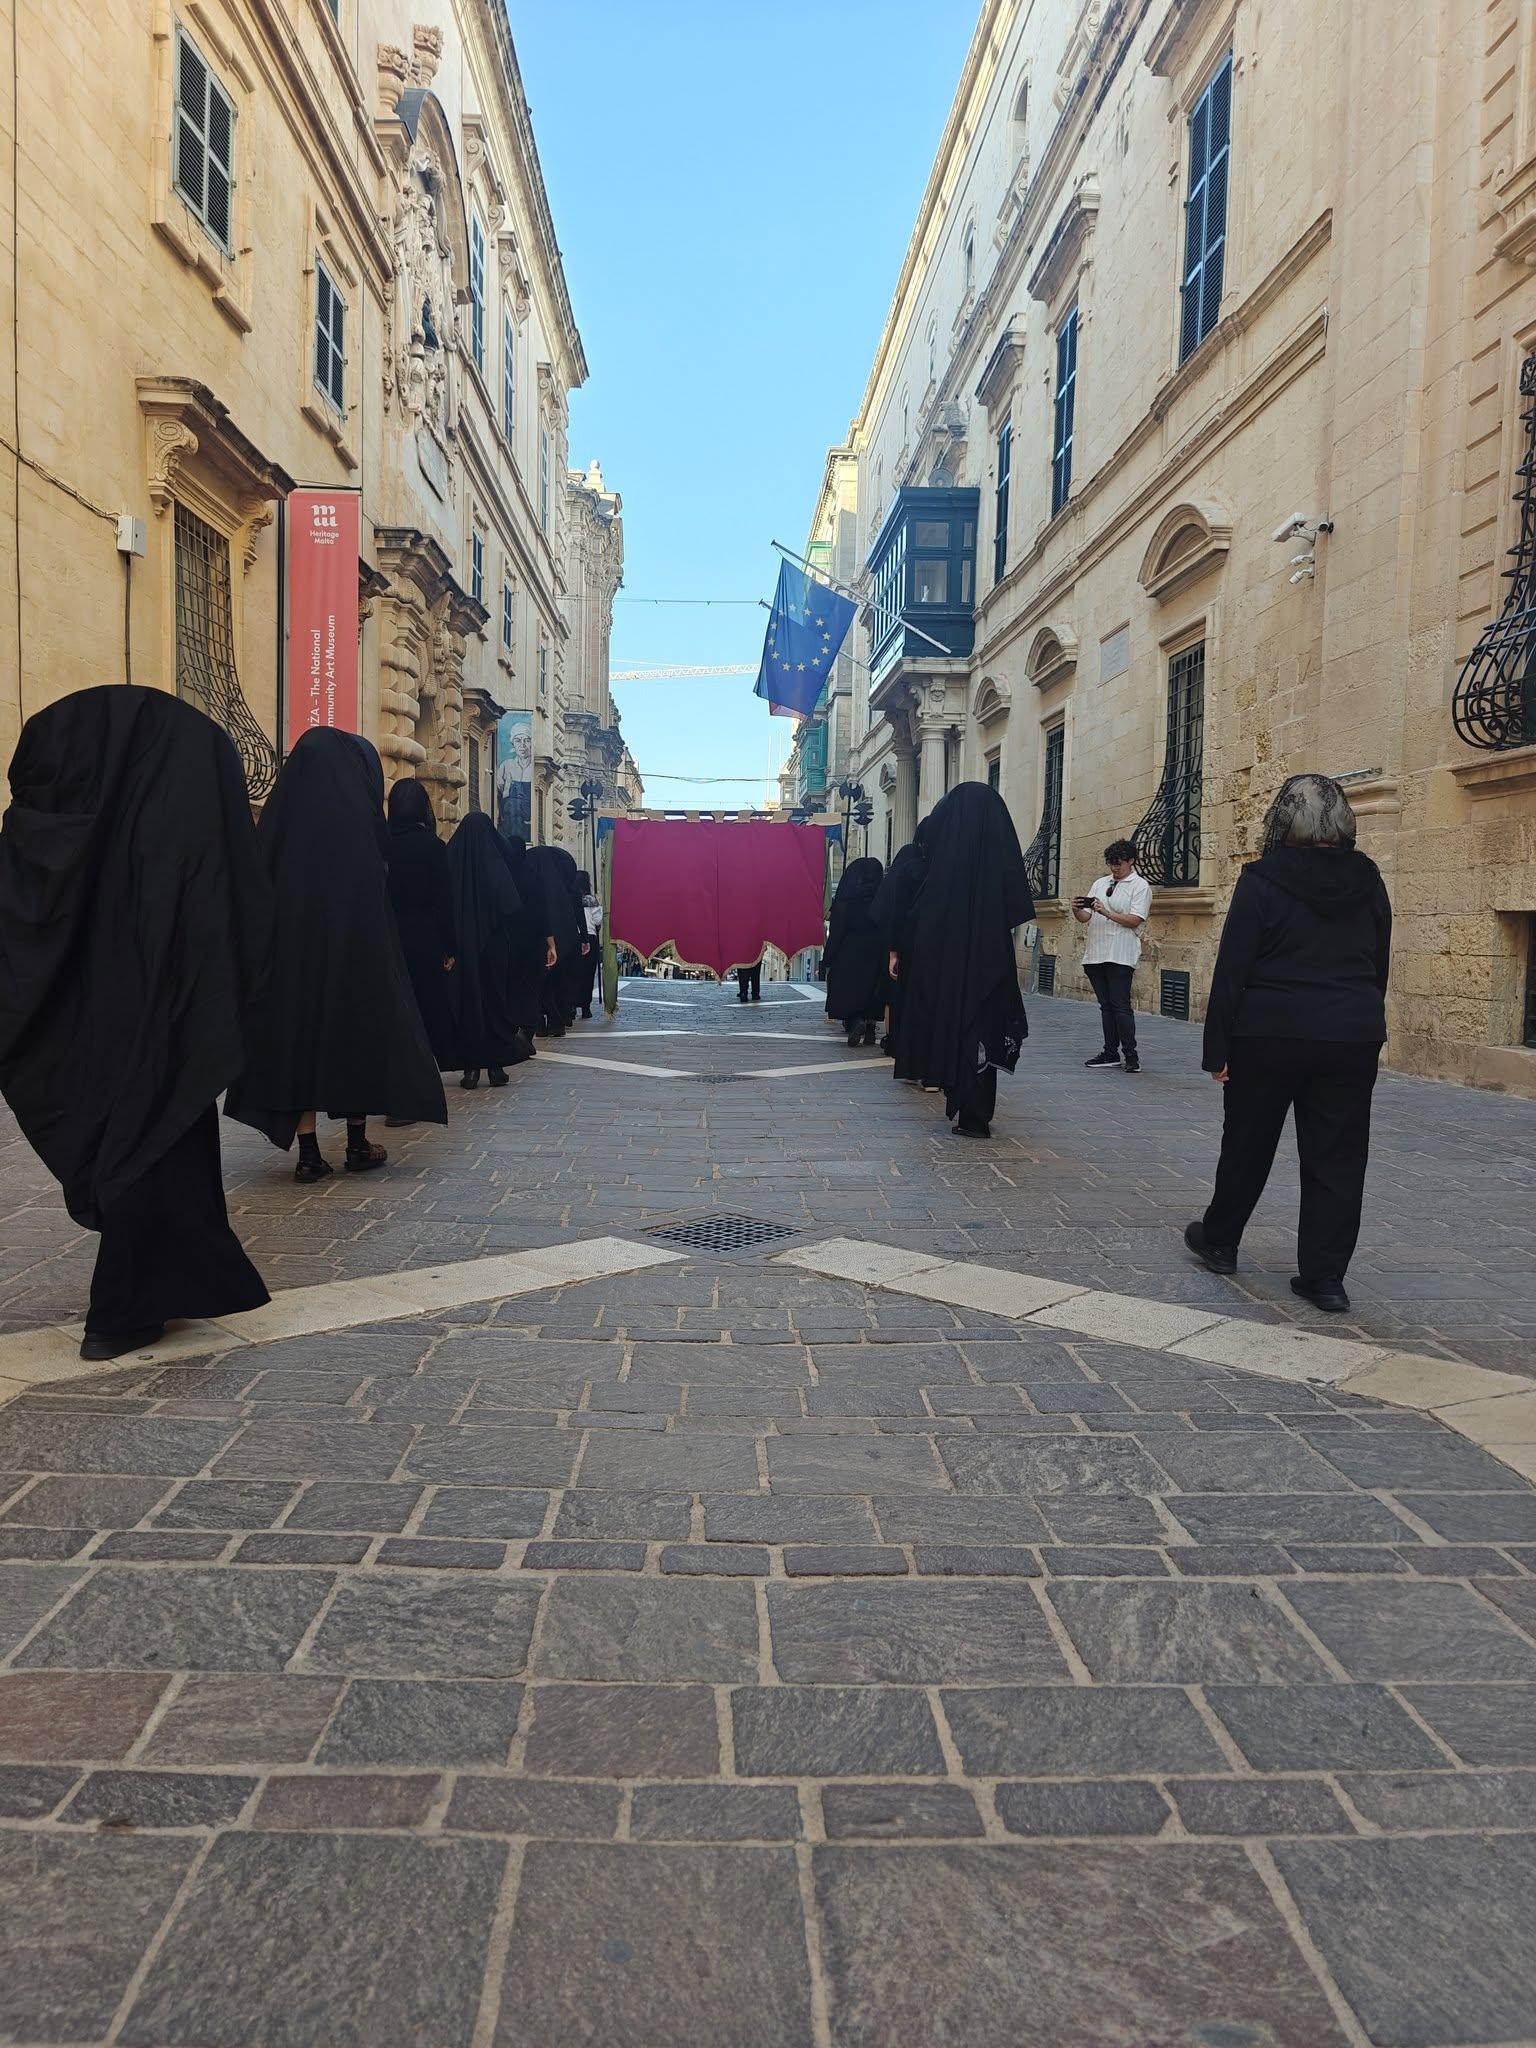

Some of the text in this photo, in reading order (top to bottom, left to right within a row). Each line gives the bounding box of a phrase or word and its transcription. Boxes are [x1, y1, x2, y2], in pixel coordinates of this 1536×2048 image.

[310, 530, 339, 539] Heritage
[325, 615, 335, 660] Museum
[310, 629, 320, 675] National
[325, 661, 335, 679] Art
[310, 677, 320, 697] The
